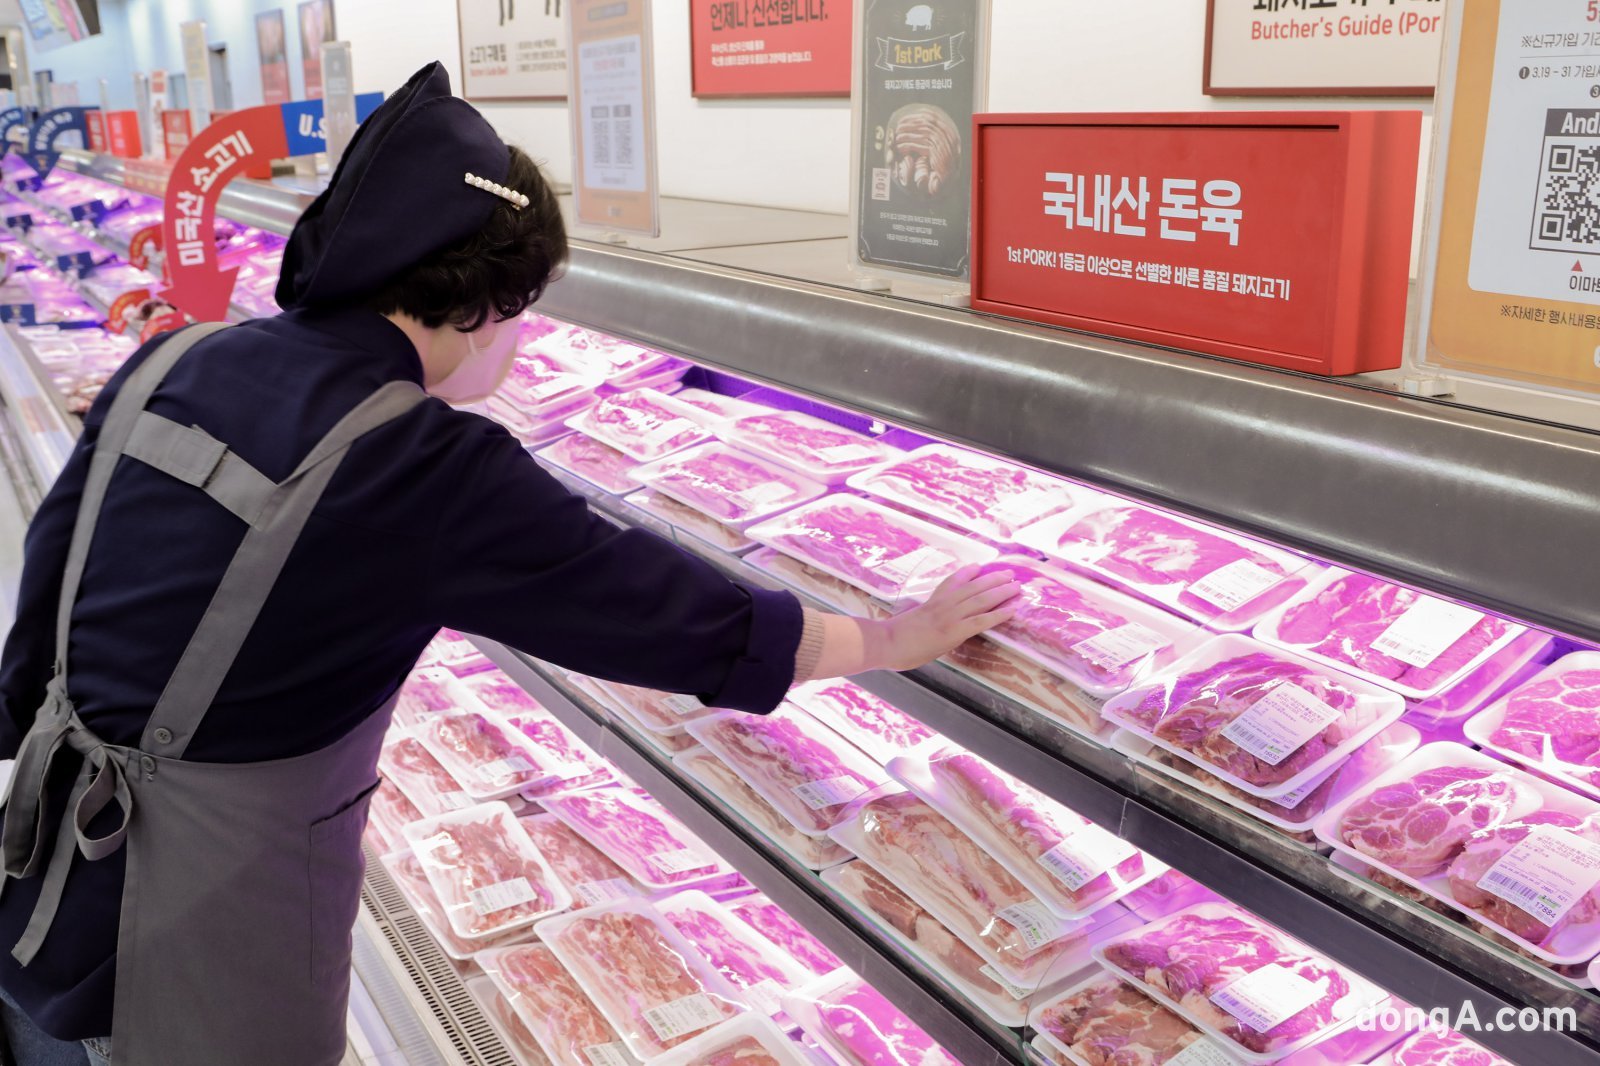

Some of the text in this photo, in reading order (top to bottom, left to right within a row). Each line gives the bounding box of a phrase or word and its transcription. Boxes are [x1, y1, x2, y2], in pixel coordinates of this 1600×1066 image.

[711, 1, 749, 31] 언제나
[1586, 0, 1600, 22] 5
[1251, 17, 1333, 40] Butcher's
[1338, 14, 1393, 37] Guide
[895, 43, 942, 64] 1st Pork
[1532, 66, 1551, 79] 3.19
[1561, 66, 1571, 78] 31
[1560, 111, 1600, 134] And
[175, 190, 205, 267] 미국산
[190, 129, 254, 193] 소고기
[1043, 172, 1243, 246] 국내산 돈육
[1007, 246, 1290, 301] 1st PORK! 1등급 이상으로 선별한 바른 품질 돼지고기
[1535, 902, 1556, 918] 17884
